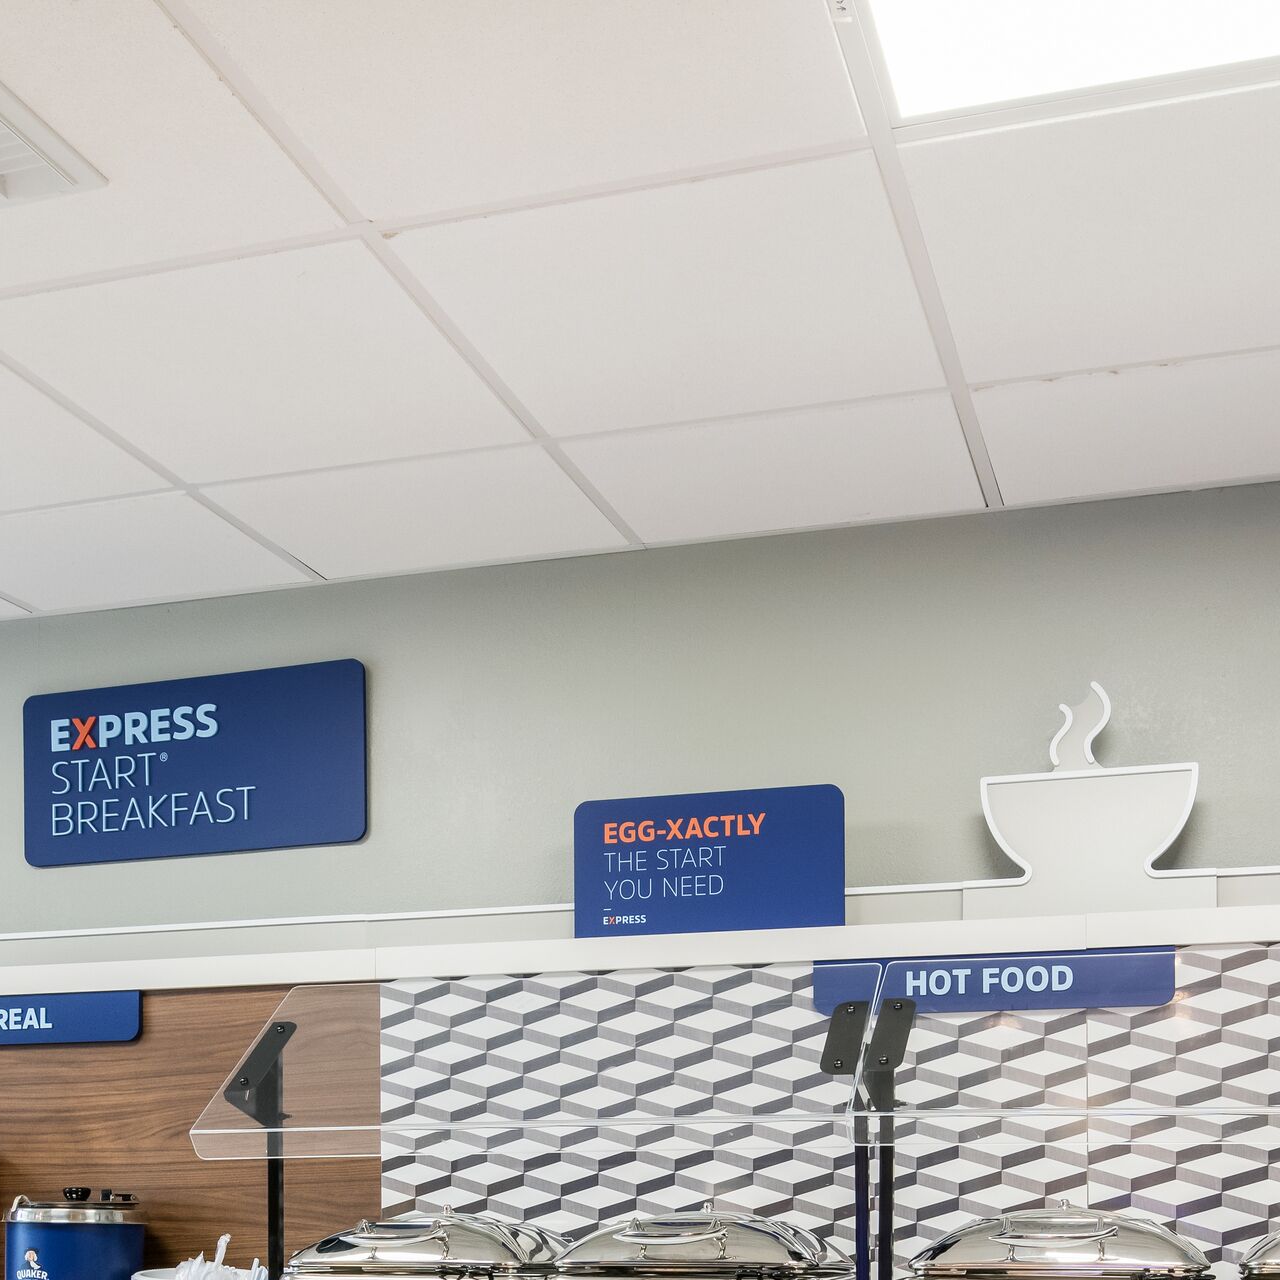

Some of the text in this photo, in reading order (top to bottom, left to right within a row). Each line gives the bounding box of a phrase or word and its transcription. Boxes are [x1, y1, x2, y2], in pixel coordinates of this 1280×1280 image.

[51, 703, 218, 752] EXPRESS
[52, 786, 256, 836] BREAKFAST
[604, 812, 766, 844] EGG-XACTLY
[604, 846, 727, 873] THE START
[604, 874, 724, 901] YOU NEED
[603, 914, 647, 925] EXPRESS
[906, 965, 1074, 996] HOT FOOD
[16, 1269, 49, 1280] QUAKER
